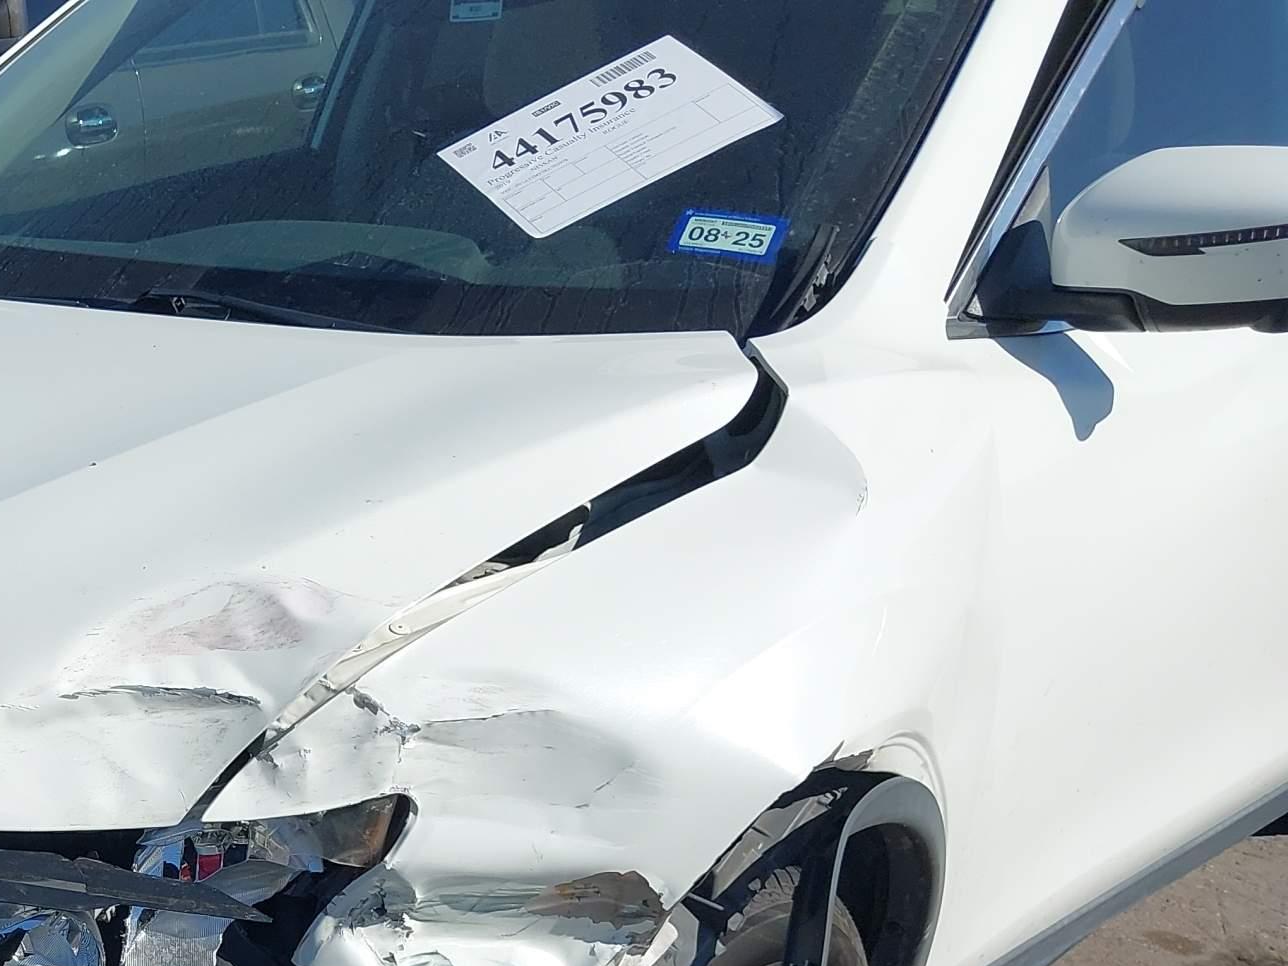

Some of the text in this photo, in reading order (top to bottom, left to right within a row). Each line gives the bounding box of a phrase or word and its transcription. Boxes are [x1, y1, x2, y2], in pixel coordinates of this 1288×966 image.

[487, 155, 544, 187] Progressive
[545, 132, 587, 157] Casualty
[589, 107, 636, 134] Insurance
[492, 68, 677, 170] 44175983
[688, 226, 721, 243] 08
[731, 231, 766, 248] 25
